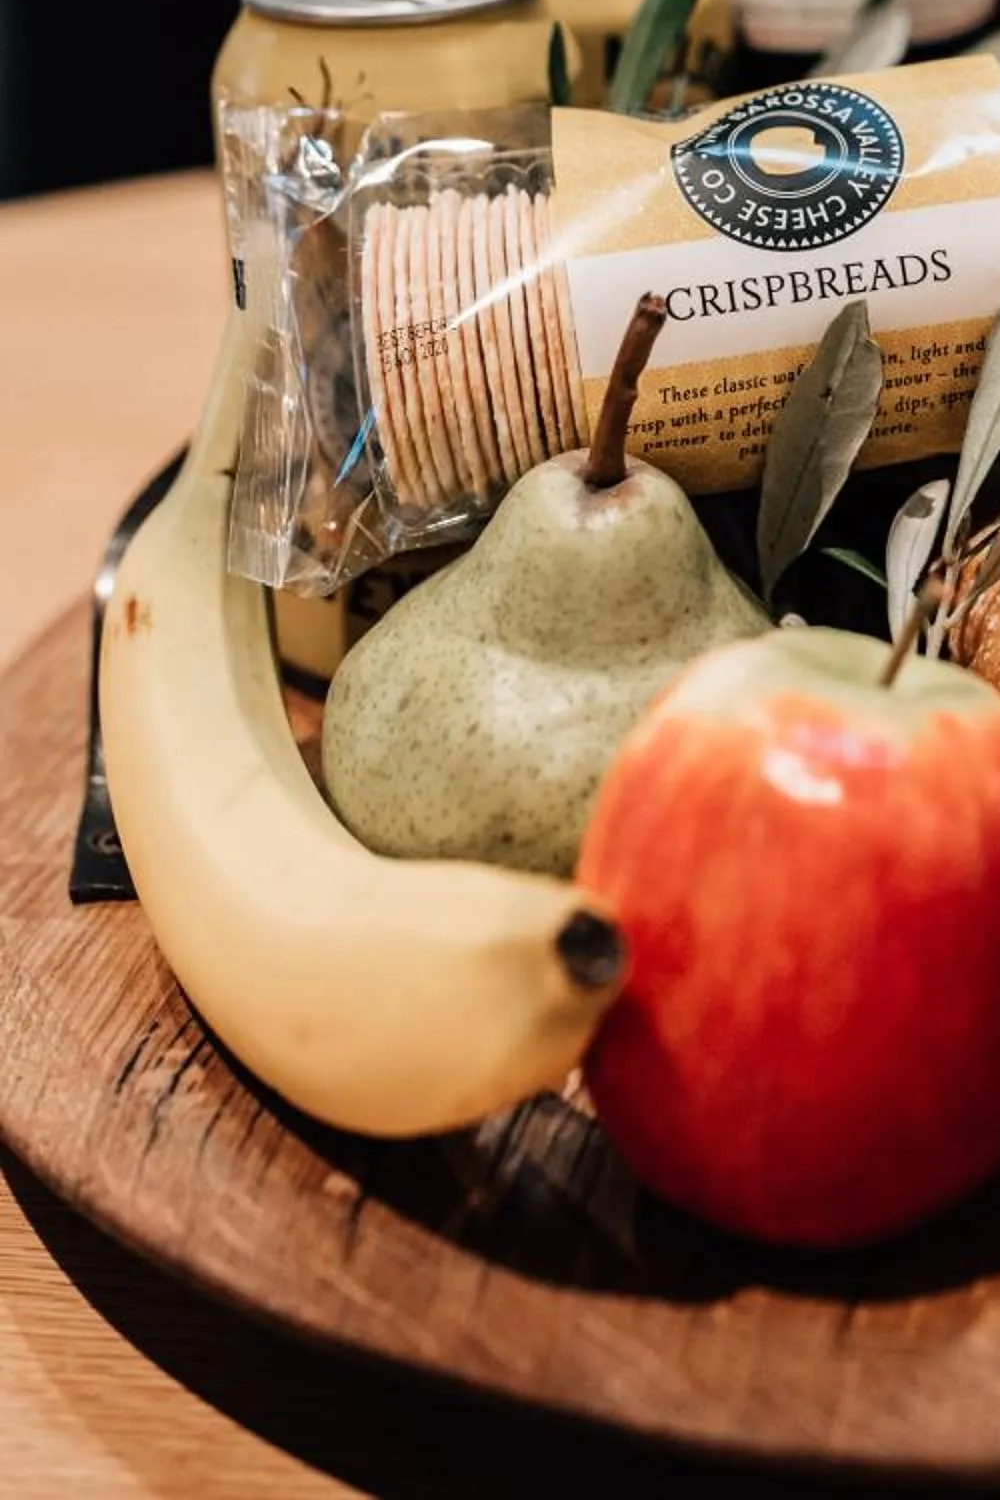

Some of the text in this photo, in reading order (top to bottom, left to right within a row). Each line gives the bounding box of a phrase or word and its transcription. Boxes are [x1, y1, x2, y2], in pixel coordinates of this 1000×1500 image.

[727, 91, 853, 124] BAROSSA
[701, 169, 736, 204] CO
[847, 120, 882, 199] VALLEY
[737, 195, 848, 231] CHEESE
[665, 249, 952, 321] CRISPBREADS
[659, 385, 709, 404] These
[713, 376, 768, 394] classic
[911, 342, 950, 365] light
[955, 336, 987, 354] and
[642, 434, 709, 453] partner
[719, 429, 735, 442] to
[895, 396, 935, 415] dips,
[671, 408, 709, 428] with
[713, 409, 723, 421] a
[884, 372, 933, 389] avour
